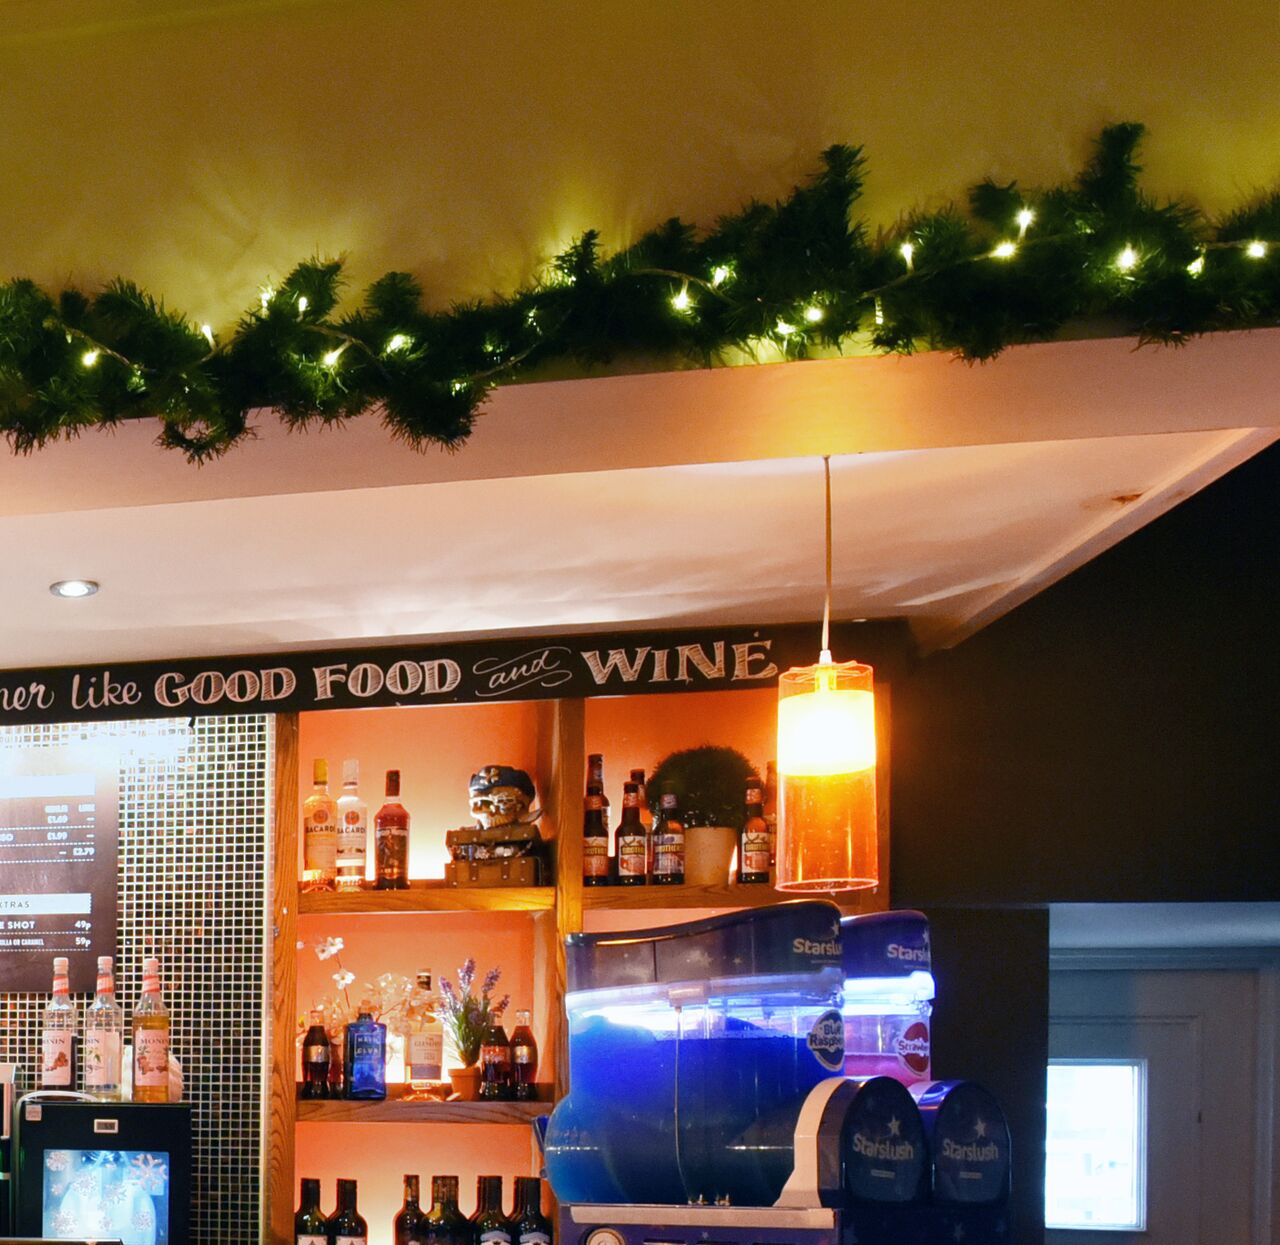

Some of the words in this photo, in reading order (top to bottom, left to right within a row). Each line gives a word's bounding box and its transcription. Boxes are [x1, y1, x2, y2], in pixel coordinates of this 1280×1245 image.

[71, 671, 142, 710] like
[154, 667, 297, 707] GOOD
[313, 658, 462, 700] FOOD
[478, 648, 568, 694] and
[581, 639, 778, 685] WINE
[8, 921, 35, 930] SHOT
[74, 920, 91, 930] 49p
[75, 937, 91, 947] 59p
[852, 1132, 914, 1160] Starslush
[943, 1137, 999, 1161] Starslush
